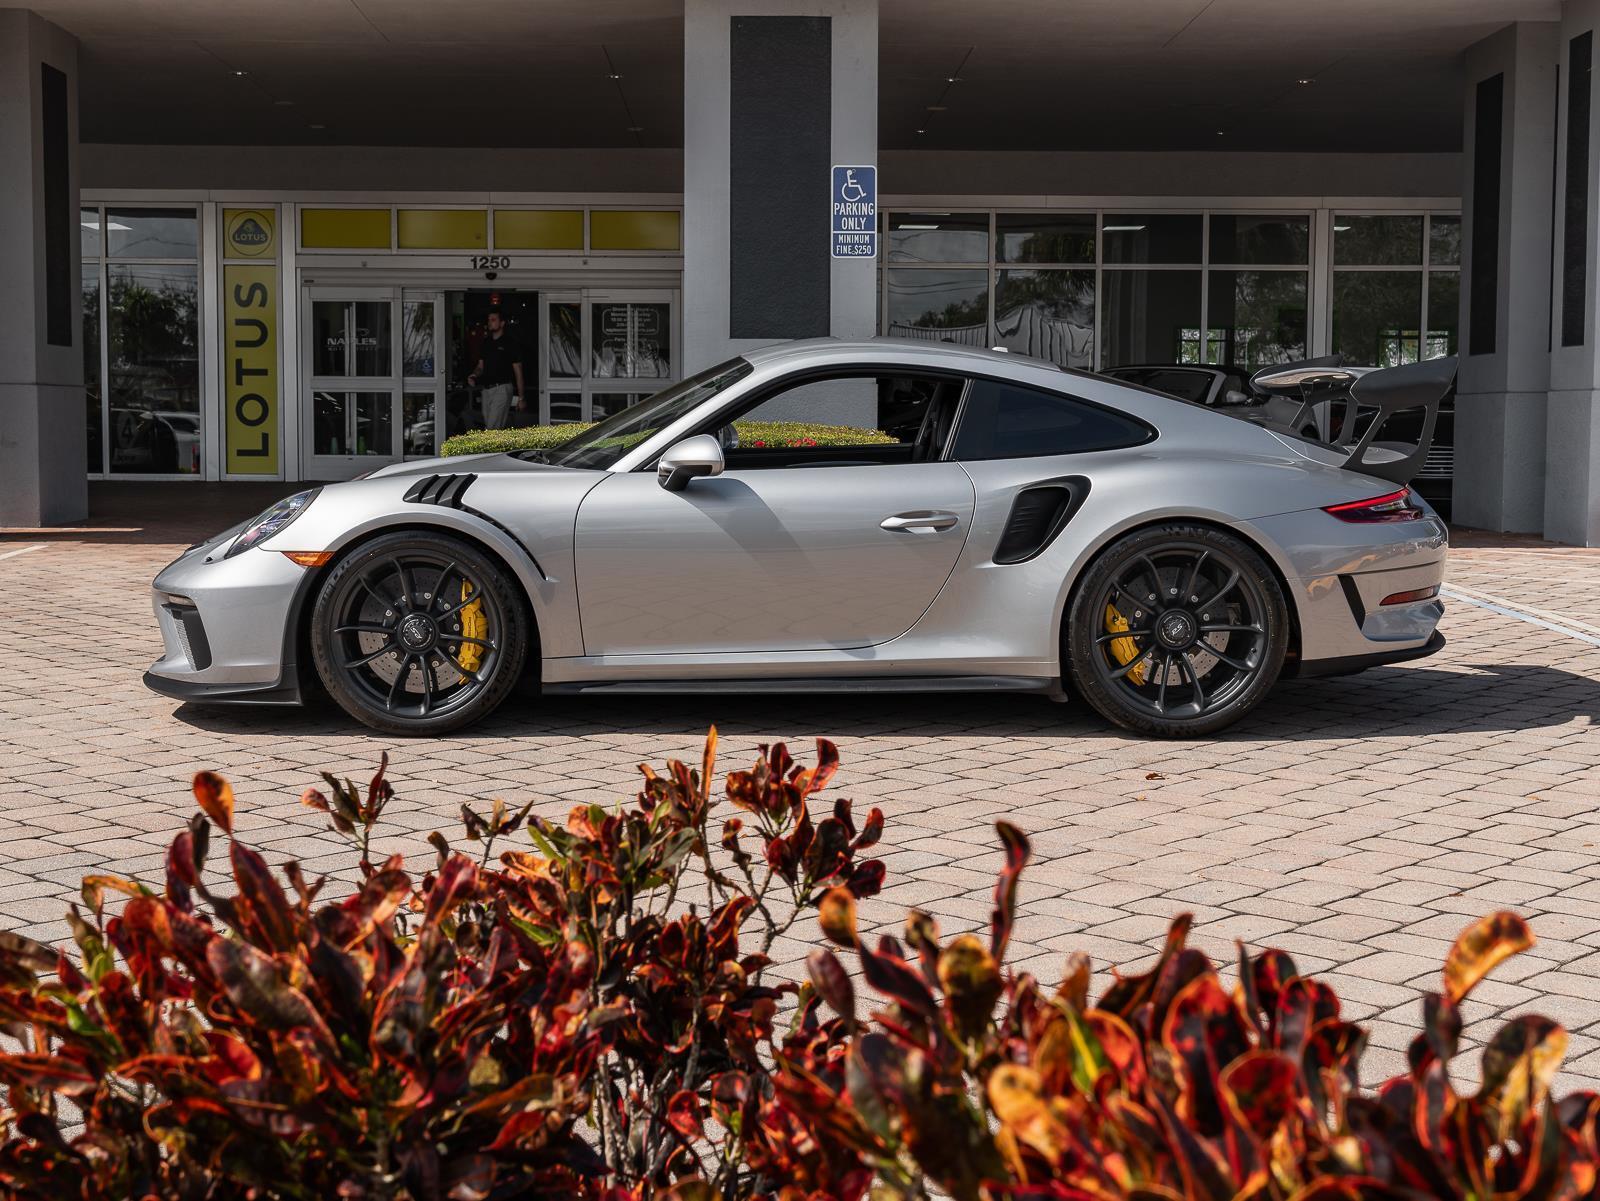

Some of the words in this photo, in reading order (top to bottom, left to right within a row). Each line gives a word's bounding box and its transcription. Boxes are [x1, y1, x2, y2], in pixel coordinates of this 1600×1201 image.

[834, 202, 874, 216] PARKING
[841, 217, 867, 230] ONLY
[235, 232, 266, 242] LOTUS
[838, 234, 870, 244] MINIMUM
[836, 245, 852, 254] FINE
[854, 244, 872, 255] $250
[470, 255, 511, 270] 1250
[233, 281, 270, 457] LOTUS
